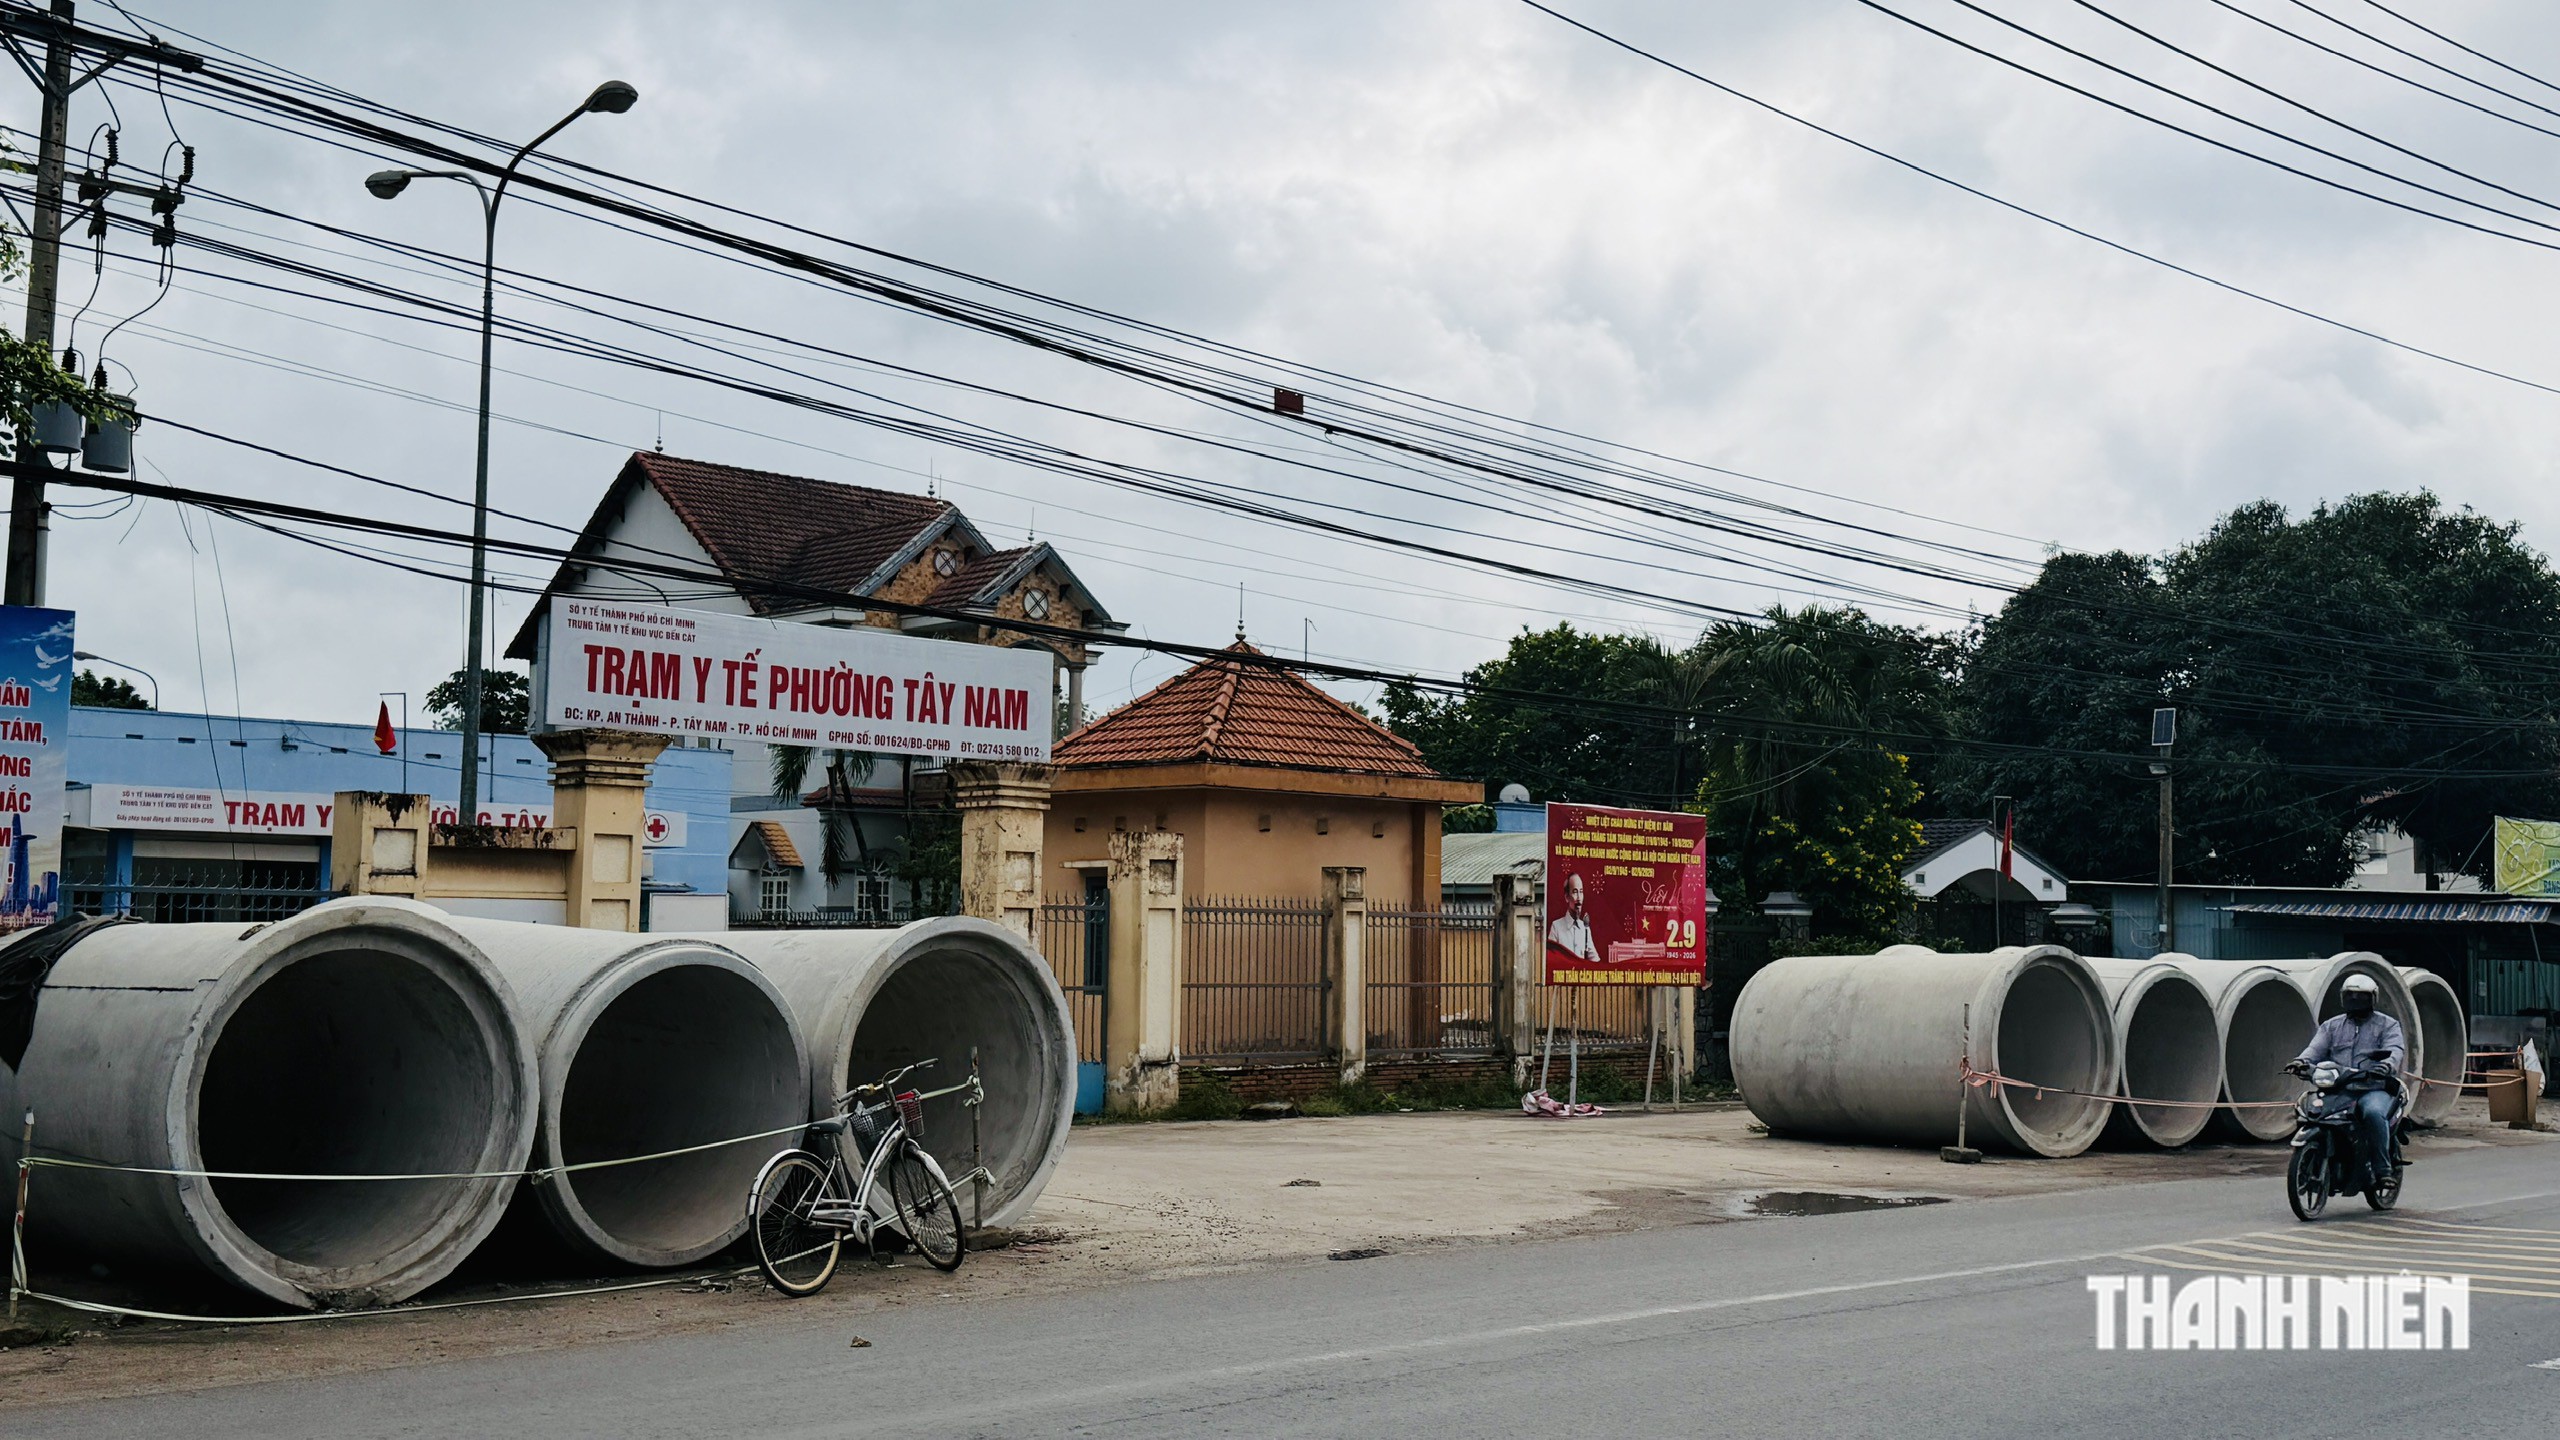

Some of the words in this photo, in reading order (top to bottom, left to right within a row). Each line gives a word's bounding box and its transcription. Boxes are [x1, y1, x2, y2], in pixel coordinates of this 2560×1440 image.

[568, 618, 593, 631] TRUNG
[613, 624, 619, 634] Y
[621, 623, 630, 635] TẾ
[632, 627, 647, 637] KHU
[649, 628, 664, 640] VỰC
[666, 629, 680, 641] BẾN
[582, 607, 587, 615] Y
[590, 605, 600, 616] TẾ
[601, 608, 627, 620] THÀNH
[629, 611, 645, 623] PHỐ
[660, 616, 673, 626] CHÍ
[675, 618, 696, 630] MINH
[584, 644, 681, 708] TRẠM
[692, 656, 713, 704] Y
[722, 648, 762, 708] TẾ
[769, 661, 894, 721] PHƯỜNG
[903, 672, 956, 725] TÂY
[964, 685, 1029, 731] NAM
[0, 717, 47, 746] TÁM,
[565, 707, 583, 720] ĐC:
[587, 709, 603, 722] KP.
[607, 711, 621, 724] AN
[625, 711, 659, 727] THÀNH
[670, 717, 680, 729] P.
[683, 716, 702, 731] TÂY
[705, 720, 727, 733] NAM
[738, 722, 752, 736] TP.
[756, 721, 769, 737] HỒ
[773, 724, 790, 738] CHÍ
[792, 728, 817, 741] MINH
[857, 730, 871, 745] SỐ:
[961, 741, 974, 753] ĐT:
[977, 743, 1004, 755] 02743
[1006, 745, 1022, 756] 580
[1023, 746, 1040, 757] 012
[224, 801, 305, 832] TRẠM
[316, 805, 333, 828] Y
[1666, 919, 1696, 948] 2.9
